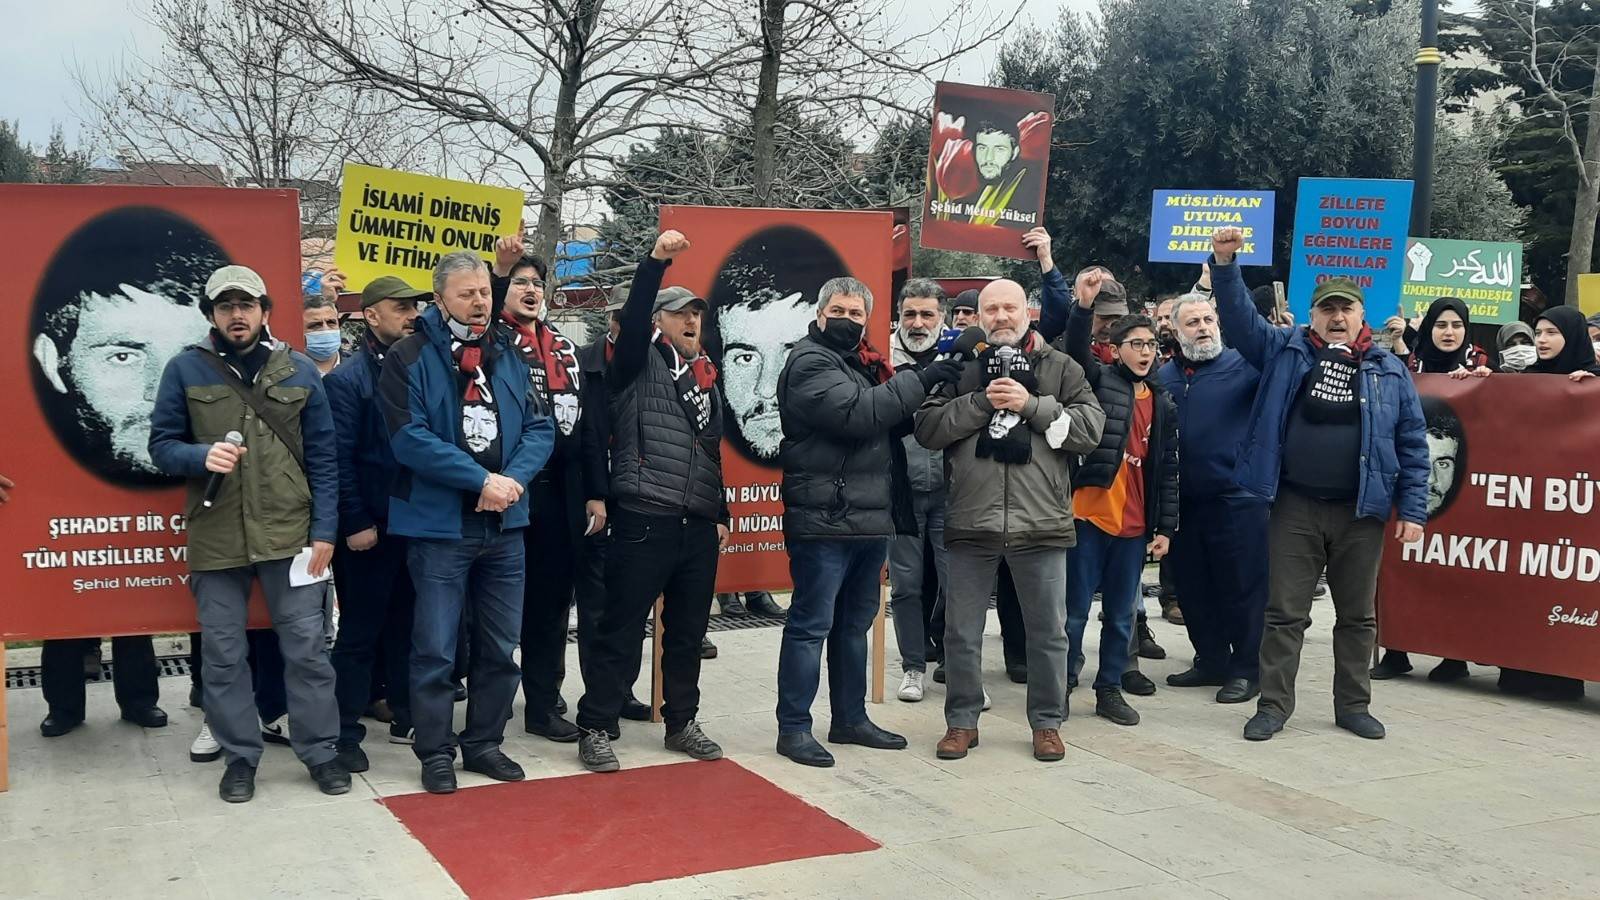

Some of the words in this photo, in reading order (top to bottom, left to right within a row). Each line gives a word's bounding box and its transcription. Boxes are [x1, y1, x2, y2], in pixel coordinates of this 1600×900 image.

[362, 183, 424, 215] İSLAMİ
[430, 196, 501, 232] DİRENİŞ
[1165, 194, 1262, 208] MÜSLÜMAN
[1319, 194, 1386, 211] ZİLLETE
[930, 200, 962, 215] Şehid
[964, 204, 996, 218] Metin
[999, 207, 1037, 224] Yüksel
[1183, 211, 1243, 223] UYUMA
[350, 209, 435, 244] ÜMMETİN
[1321, 216, 1379, 230] BOYUN
[1304, 233, 1392, 250] EĞENLERE
[358, 241, 379, 263] VE
[1305, 254, 1388, 269] YAZIKLAR
[1403, 282, 1454, 297] ÜMMETİZ
[1456, 287, 1513, 303] KARDEŞİZ
[1323, 366, 1351, 381] İBADET
[1323, 376, 1348, 388] HAKKI
[1314, 382, 1353, 395] MÜDAFAA
[740, 482, 783, 502] BÜYÜ
[1470, 473, 1533, 509] "EN
[49, 515, 131, 539] ŞEHADET
[136, 511, 164, 532] BİR
[22, 547, 66, 569] TÜM
[72, 544, 165, 567] NESİLLERE
[1402, 532, 1509, 572] HAKKI
[73, 577, 119, 593] Şehid
[125, 573, 172, 587] Metin
[1548, 605, 1598, 627] Şehid
